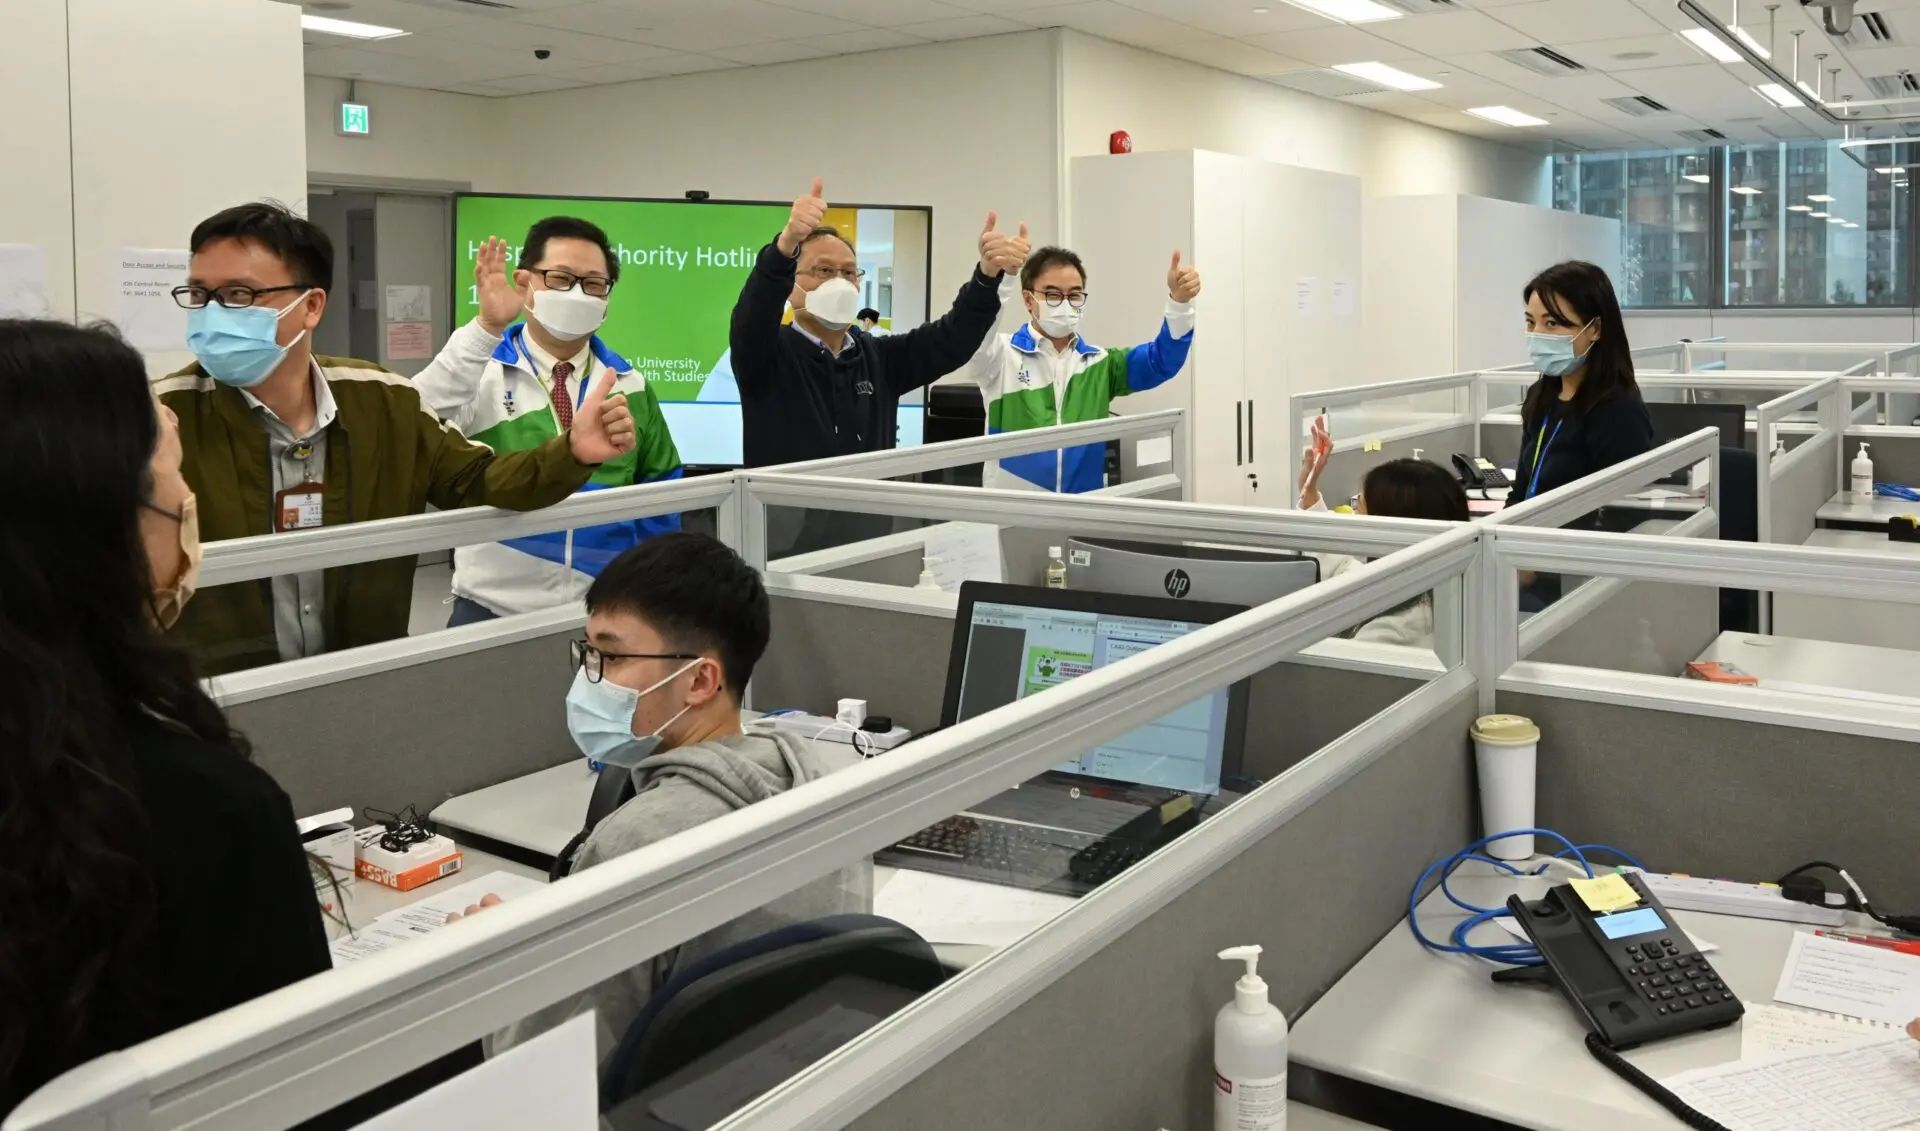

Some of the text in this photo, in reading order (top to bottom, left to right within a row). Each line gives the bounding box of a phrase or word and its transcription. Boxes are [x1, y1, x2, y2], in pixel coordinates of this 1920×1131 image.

[610, 243, 757, 271] hority Hotli
[637, 356, 701, 372] University
[664, 369, 710, 383] Studies
[1166, 569, 1188, 598] hp
